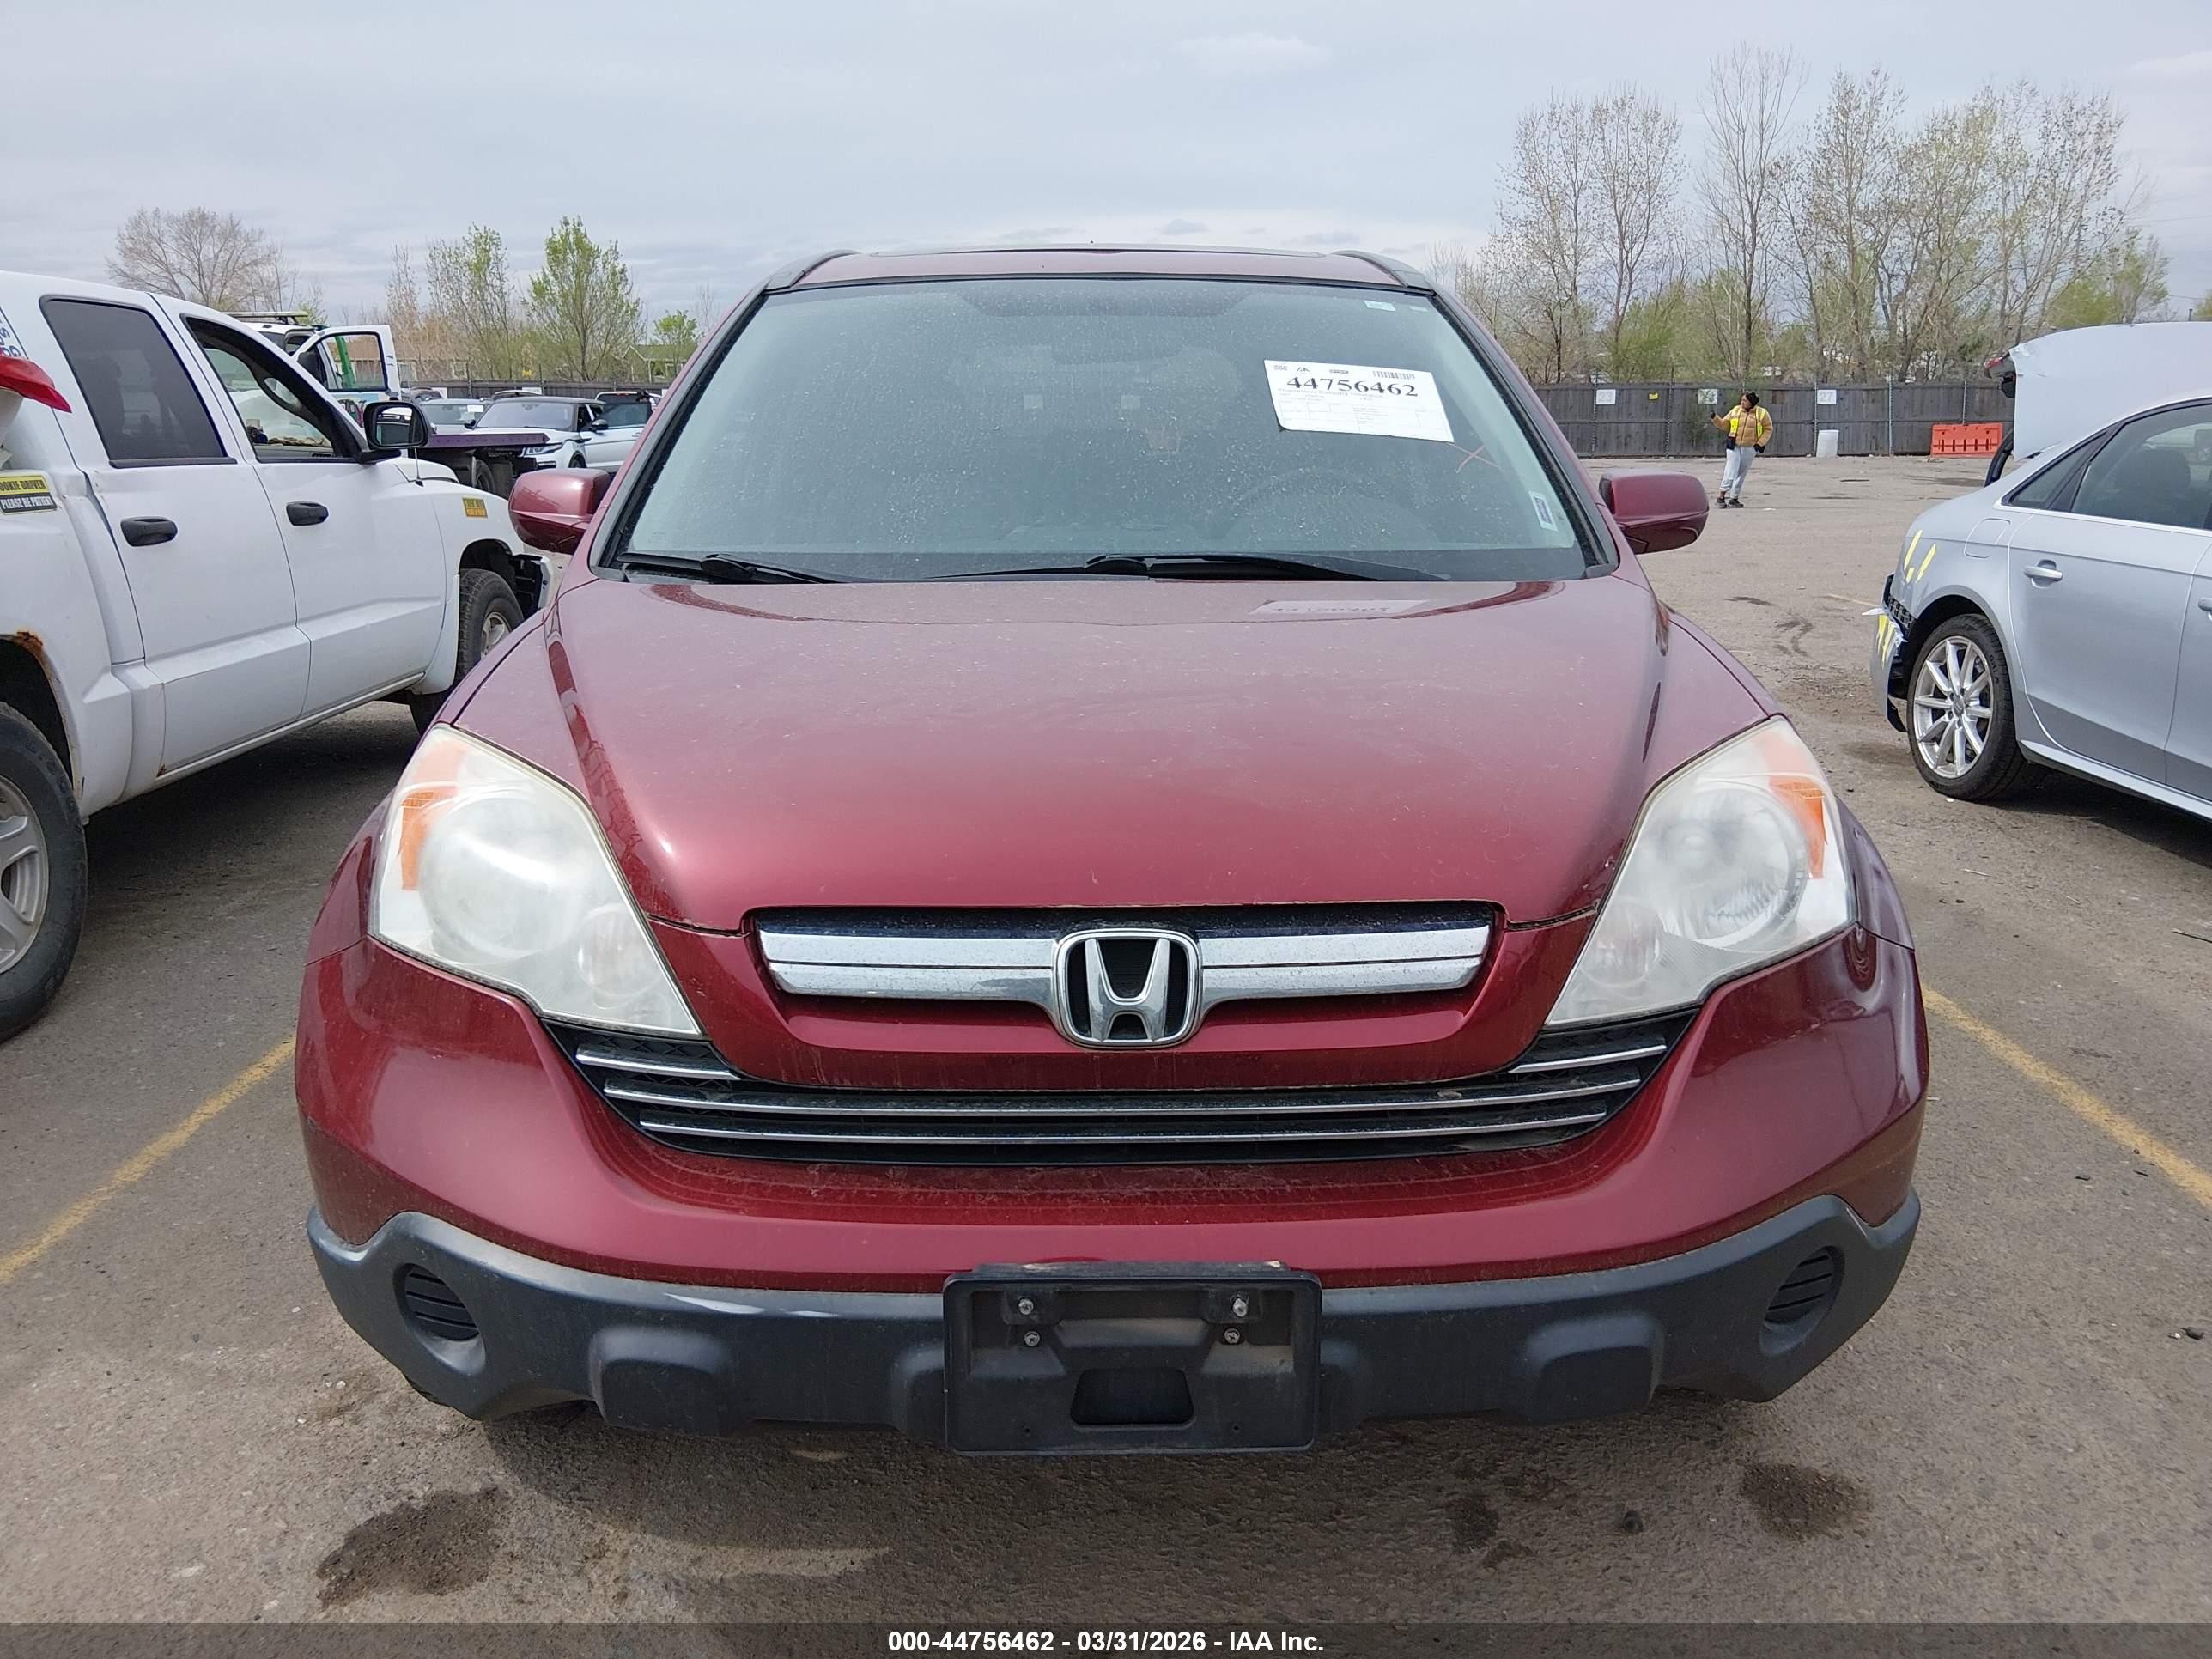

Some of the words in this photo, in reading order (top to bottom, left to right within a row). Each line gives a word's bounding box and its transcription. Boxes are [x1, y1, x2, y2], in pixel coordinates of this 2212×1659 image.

[1286, 376, 1419, 397] 44756462
[1819, 391, 1834, 403] 27
[19, 479, 47, 490] DRIVER
[0, 498, 25, 510] PLEASE
[29, 495, 54, 507] PATIENT
